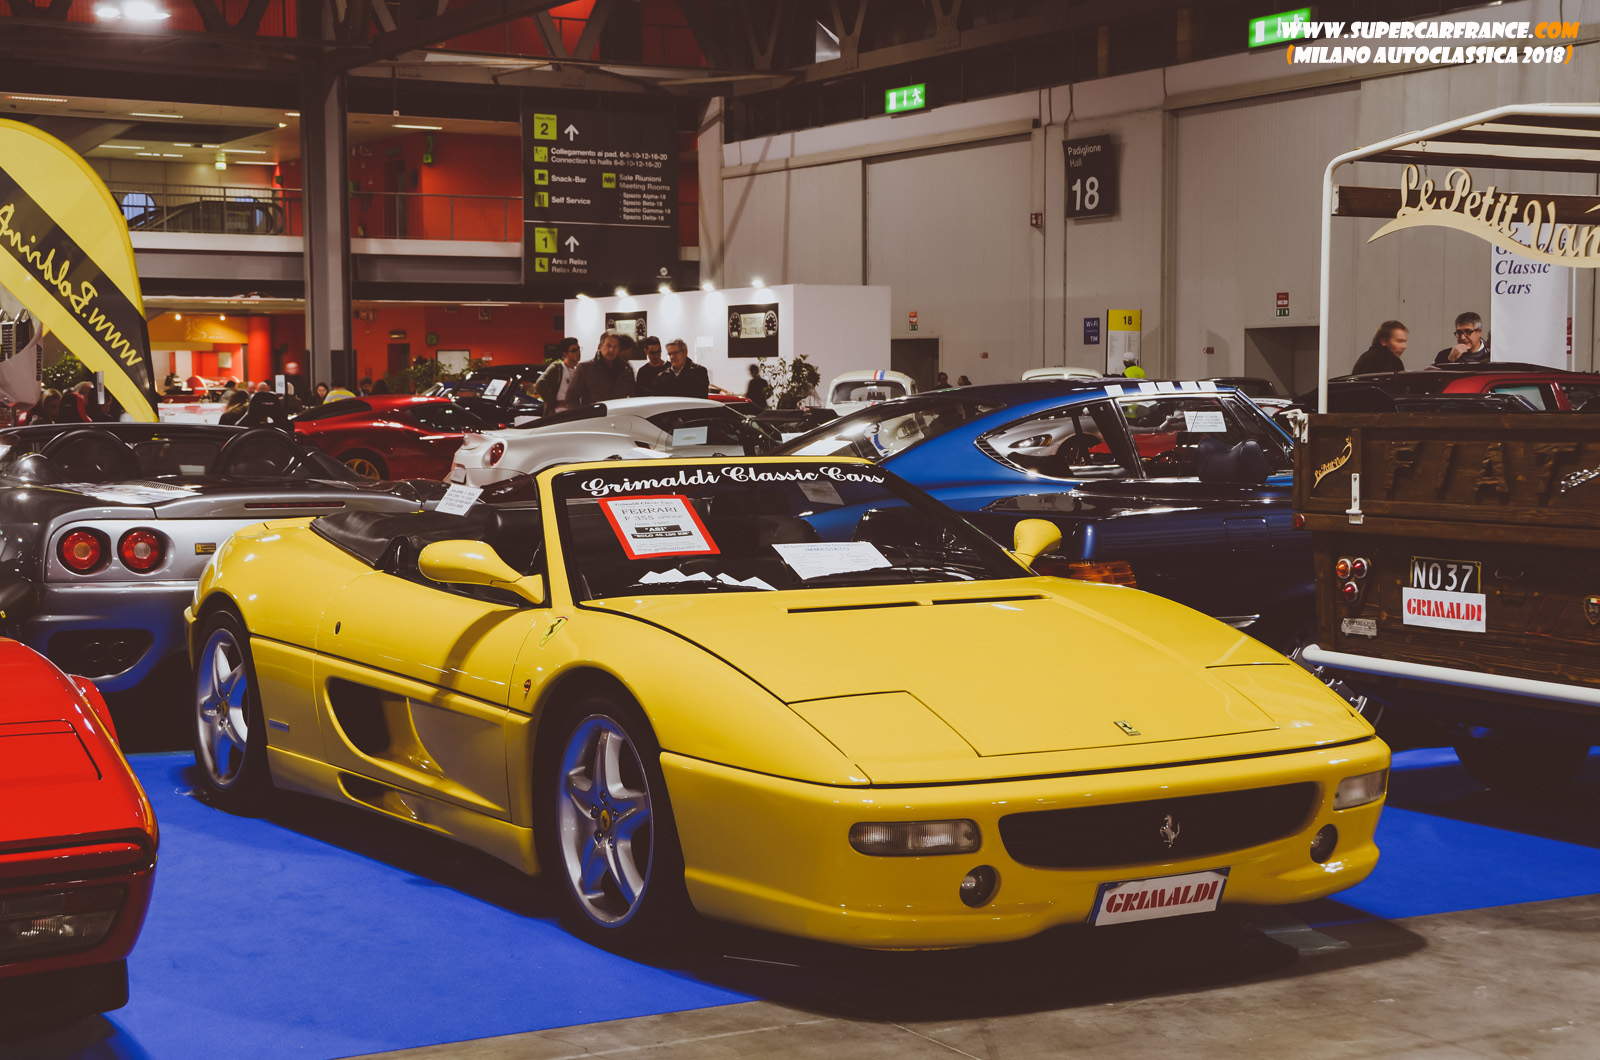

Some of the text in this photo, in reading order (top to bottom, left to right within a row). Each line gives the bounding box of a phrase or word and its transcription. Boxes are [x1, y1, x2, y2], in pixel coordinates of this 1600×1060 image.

[540, 123, 549, 135] 2
[550, 147, 596, 157] Collegamento
[1067, 144, 1102, 156] Padiglione
[550, 156, 589, 164] Connection
[597, 158, 612, 166] halls
[1069, 158, 1083, 167] Hall
[551, 175, 587, 183] Snack-Bar
[619, 183, 646, 191] Meeting
[622, 192, 641, 200] Spazio
[1071, 176, 1100, 211] 18
[566, 197, 591, 205] Service
[1397, 164, 1437, 218] Le
[1440, 168, 1519, 237] Petit
[542, 236, 548, 248] 1
[551, 258, 588, 266] Area Relax
[1495, 260, 1551, 275] Classic
[551, 266, 570, 274] Relax
[1495, 280, 1532, 295] Cars
[1123, 315, 1133, 325] 18
[1383, 441, 1578, 497] FIAT
[581, 466, 885, 496] Grimaldi Classic Cars
[621, 506, 678, 515] FERRARI
[1406, 598, 1482, 622] GRIMALDI
[1105, 880, 1219, 913] GRIMALDI
